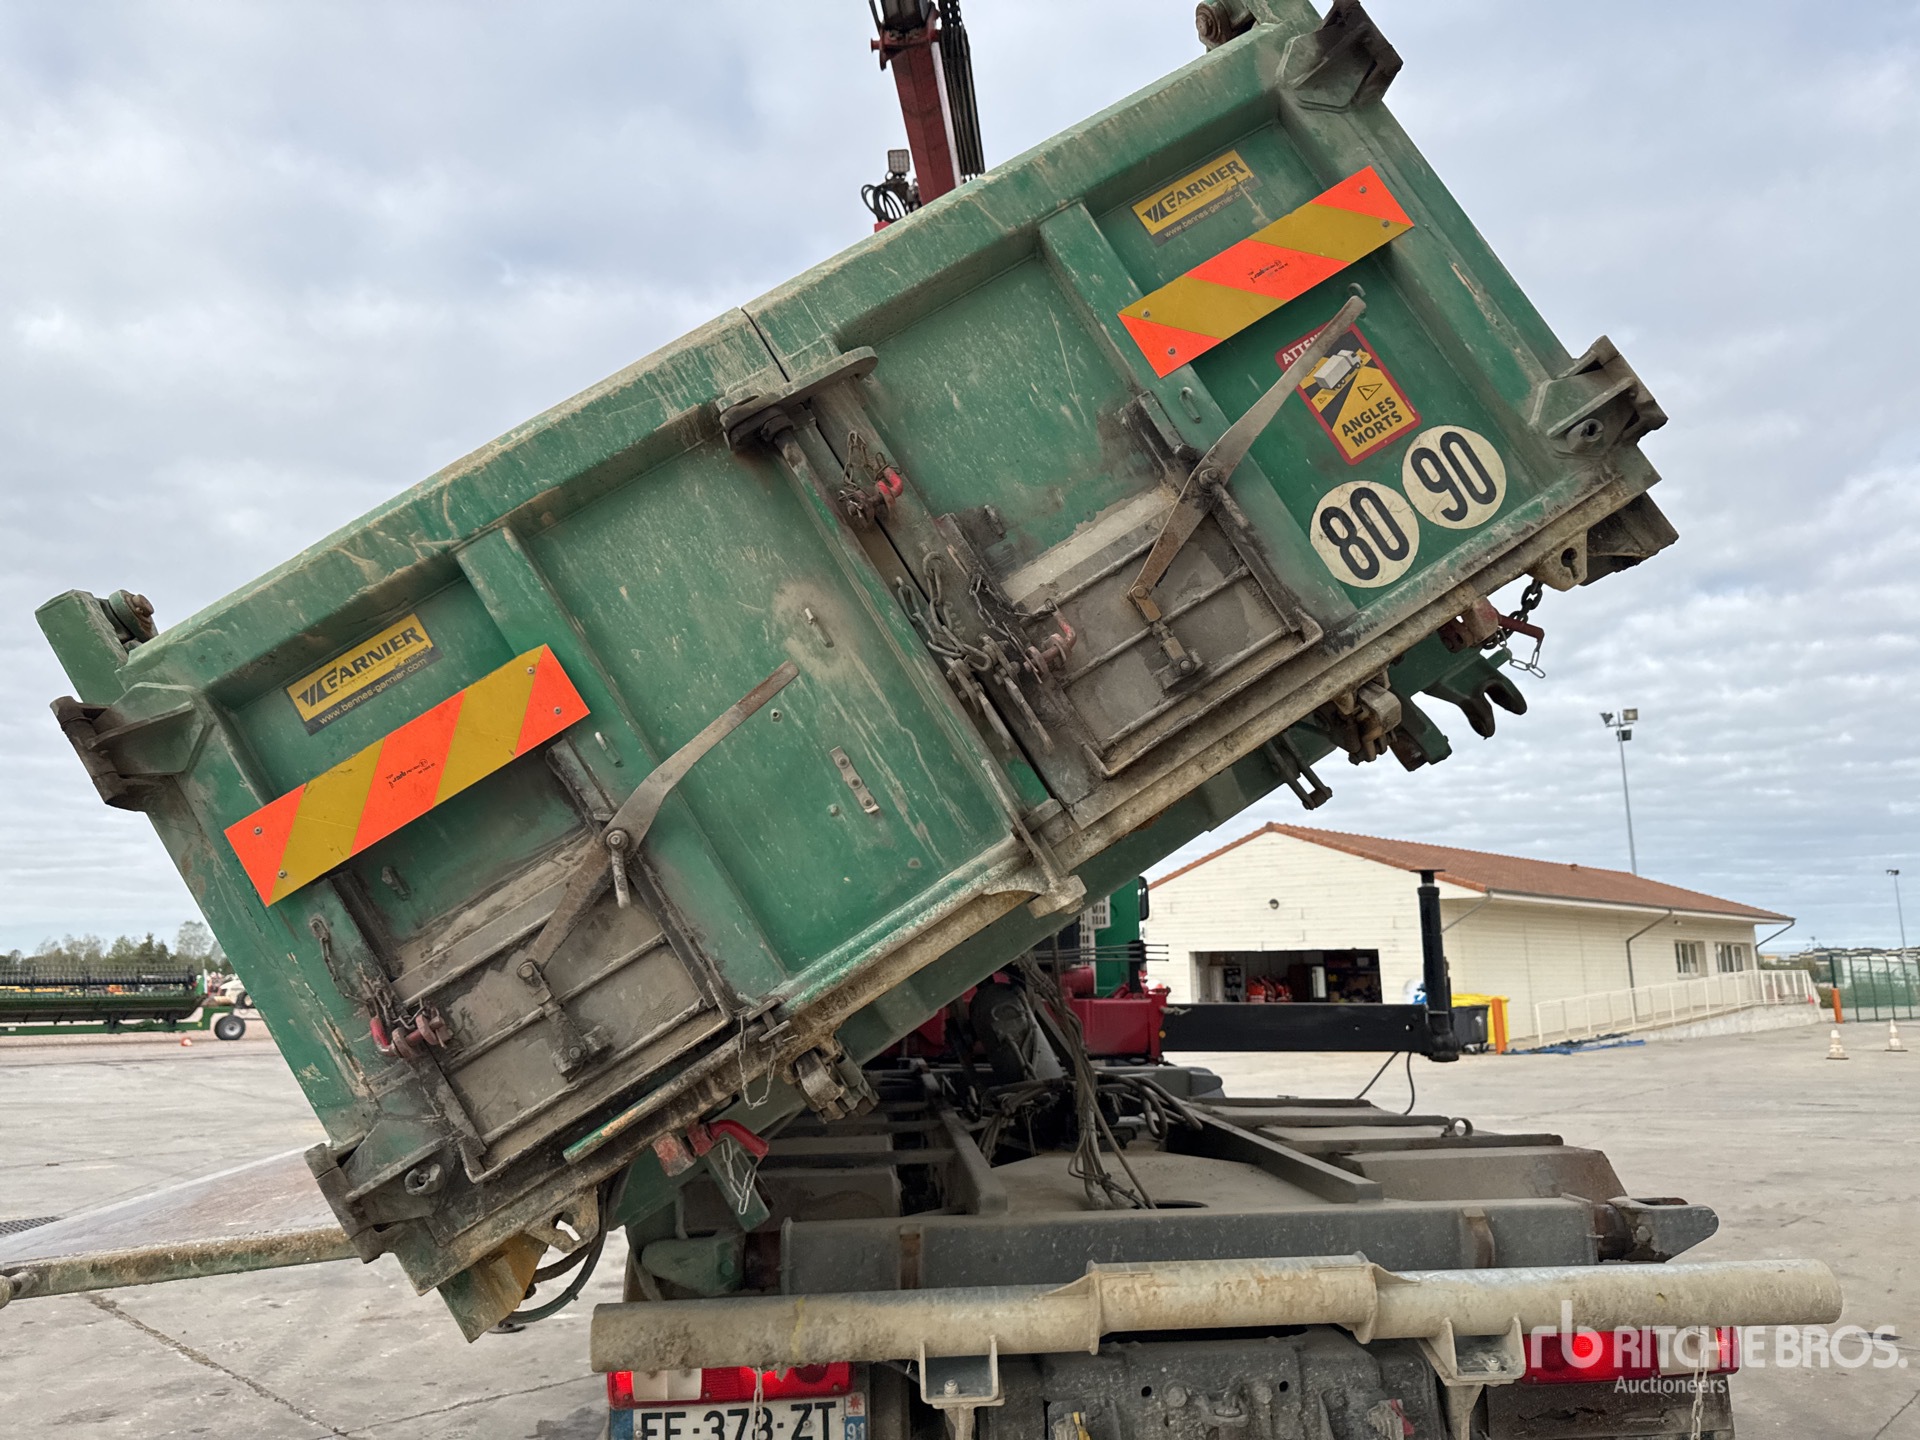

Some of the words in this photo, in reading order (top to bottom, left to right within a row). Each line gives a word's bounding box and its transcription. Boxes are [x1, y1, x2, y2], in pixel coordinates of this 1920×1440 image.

[1158, 160, 1246, 218] GARNIER
[1164, 185, 1250, 238] www.bennes-garnier.cm
[1341, 396, 1396, 437] ANGLES
[1351, 410, 1403, 448] MORTS
[1410, 431, 1497, 522] 90
[1319, 487, 1410, 581] 80
[317, 626, 425, 704] GARNIER
[319, 658, 427, 725] www.bennes-garnier.com
